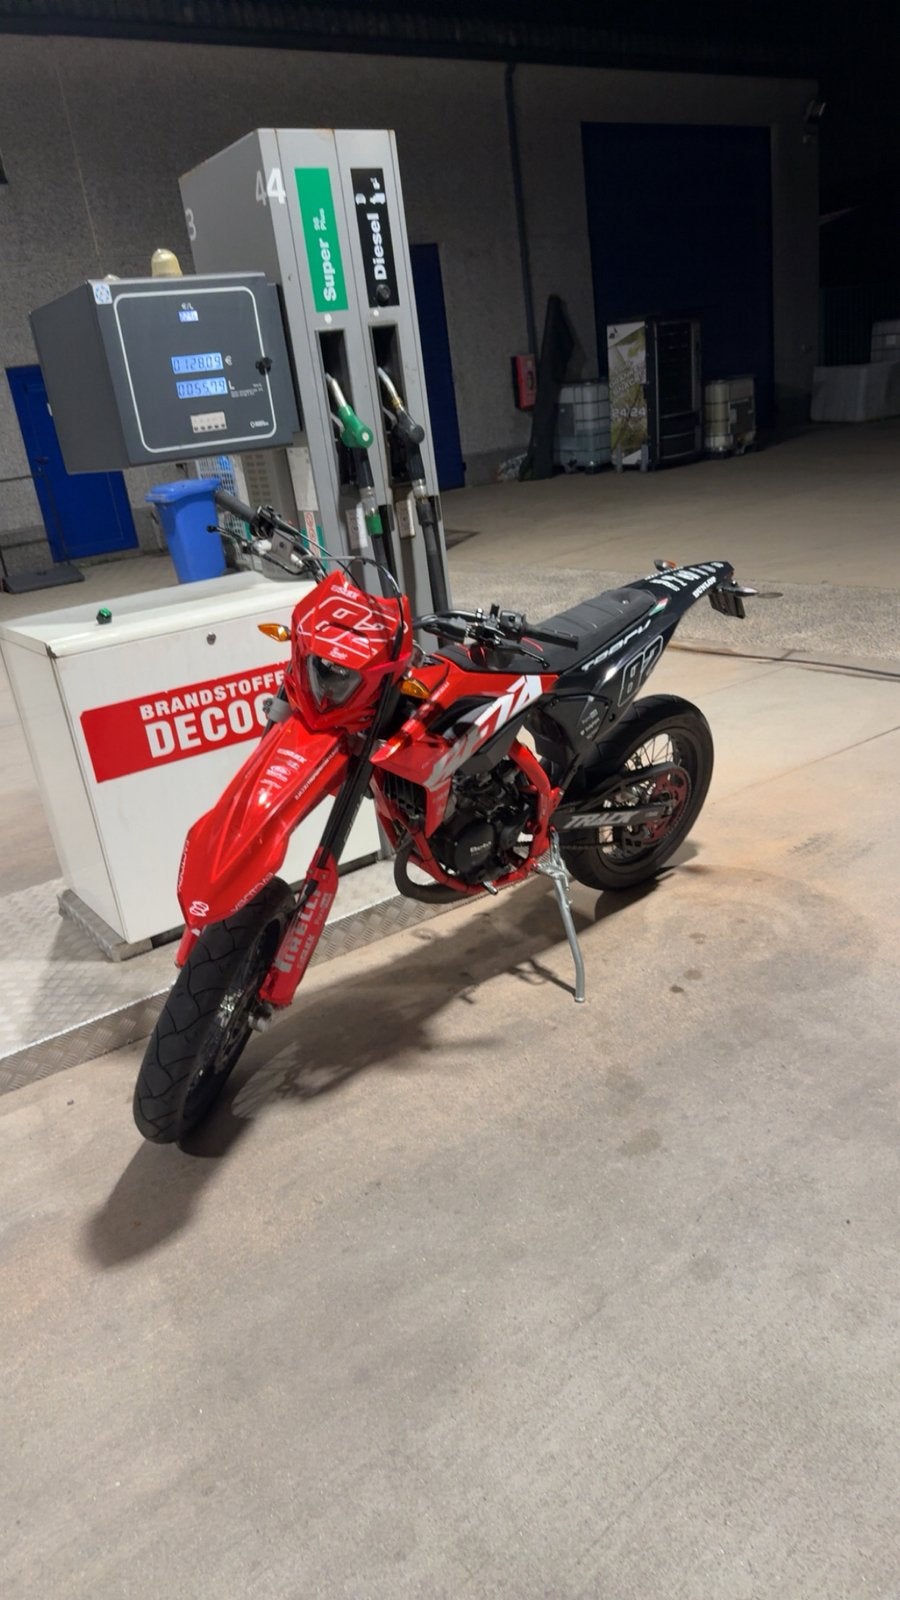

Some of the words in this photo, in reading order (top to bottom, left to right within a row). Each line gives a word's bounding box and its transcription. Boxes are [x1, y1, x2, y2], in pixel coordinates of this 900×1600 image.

[266, 167, 286, 205] 4
[366, 212, 388, 280] Diesel
[318, 237, 337, 302] Super
[692, 575, 716, 599] DUNLOP
[563, 810, 640, 830] TRACK
